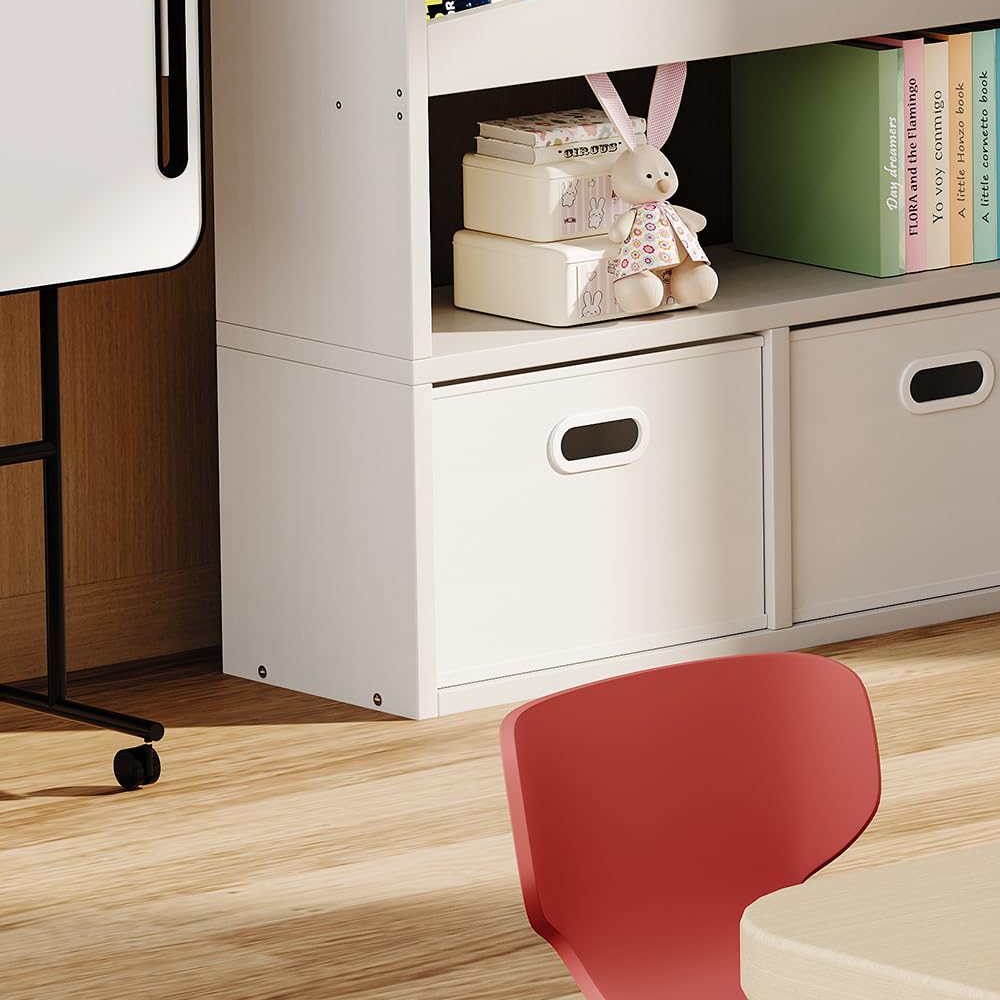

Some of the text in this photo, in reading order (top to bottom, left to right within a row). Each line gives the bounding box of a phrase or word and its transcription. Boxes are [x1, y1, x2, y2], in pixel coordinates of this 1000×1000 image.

[884, 116, 902, 212] Day dreamers
[906, 78, 919, 236] FLORA and the Flamingo
[932, 90, 945, 224] Yo voy conmigo
[955, 82, 966, 218] A little Honzo book
[979, 71, 990, 223] A little cornetto book
